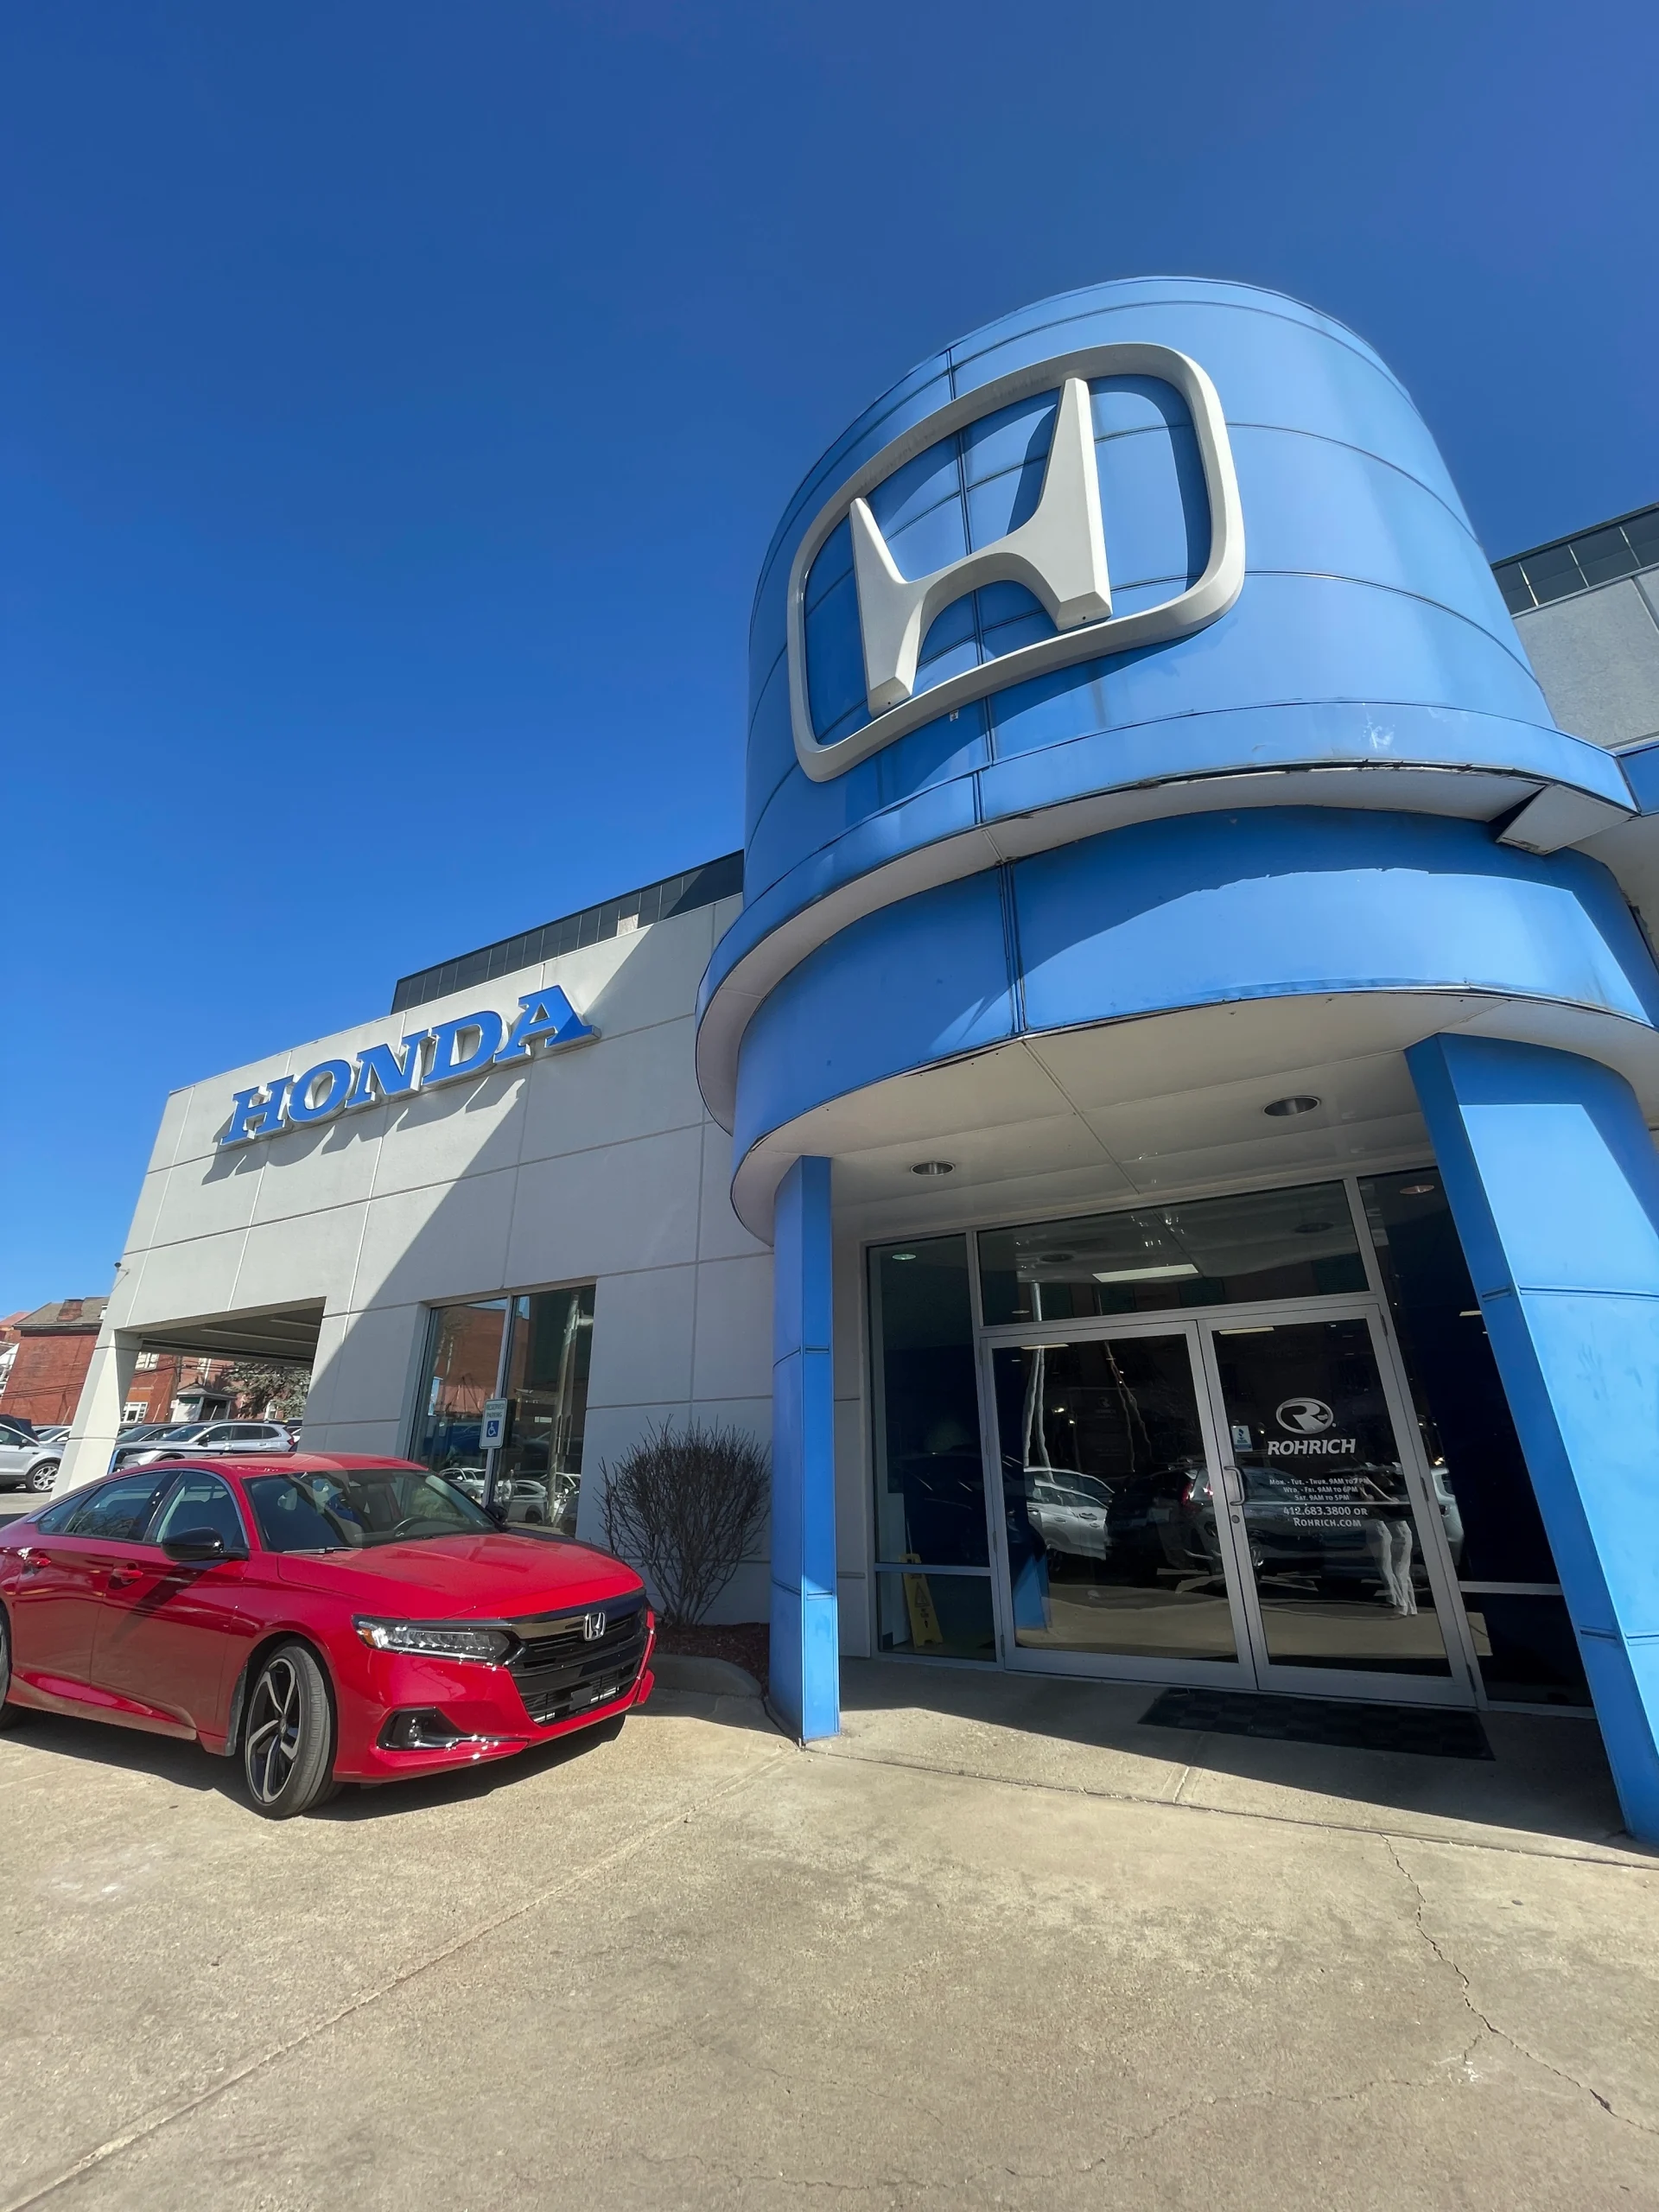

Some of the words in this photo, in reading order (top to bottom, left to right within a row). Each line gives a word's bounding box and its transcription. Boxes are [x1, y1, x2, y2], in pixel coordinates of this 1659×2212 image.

[220, 985, 601, 1147] HONDA
[1267, 1439, 1356, 1455] ROHRICH
[1283, 1506, 1351, 1516] 412.683.3800
